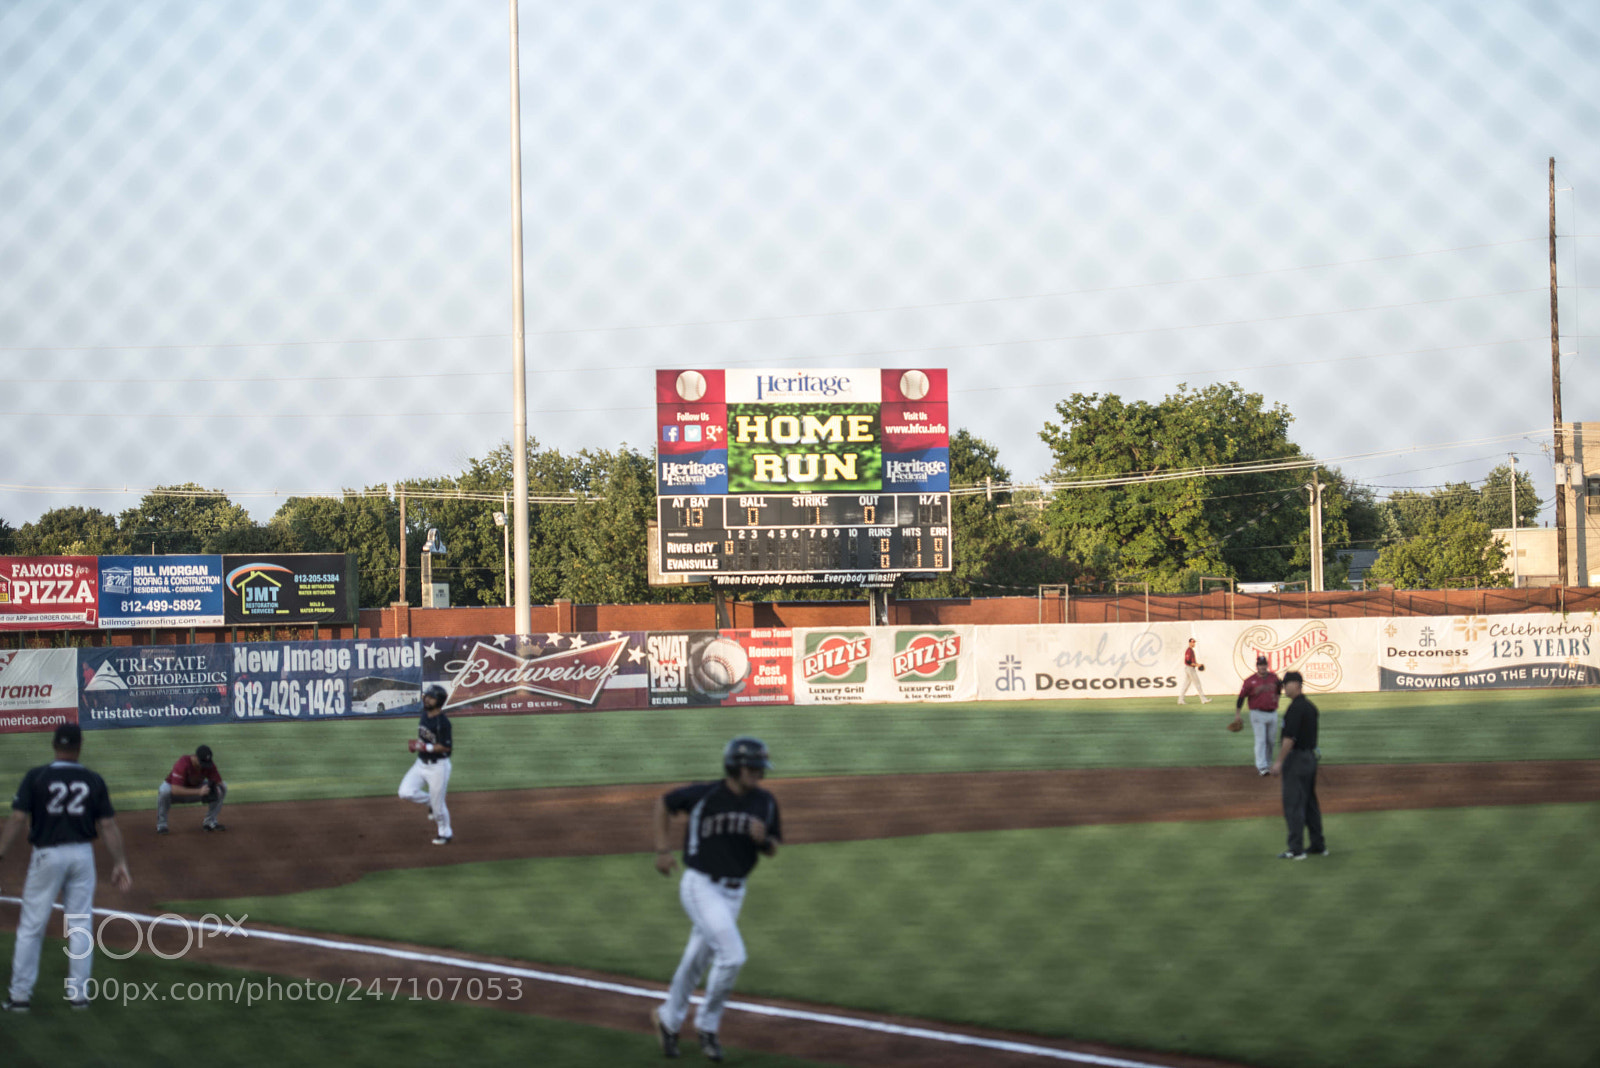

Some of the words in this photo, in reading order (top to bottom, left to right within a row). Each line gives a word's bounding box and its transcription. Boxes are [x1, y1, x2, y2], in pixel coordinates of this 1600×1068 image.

[757, 373, 850, 400] Heritage
[677, 412, 700, 421] Follow
[700, 412, 709, 421] Us
[903, 412, 918, 420] Visit
[919, 412, 928, 420] Us
[736, 415, 874, 444] HOME
[885, 424, 946, 434] www.hfcu.info
[662, 461, 726, 480] Heritage
[753, 453, 858, 482] RUN
[886, 459, 947, 478] Heritage
[667, 473, 706, 486] Federal
[891, 471, 927, 483] Federal
[672, 498, 685, 508] AT
[690, 498, 710, 508] BAT
[740, 497, 767, 507] BALL
[792, 496, 828, 507] STRIKE
[859, 496, 879, 505] OUT
[920, 495, 941, 505] H/E
[686, 508, 703, 527] 13
[748, 507, 759, 526] 0
[816, 506, 820, 524] 1
[864, 505, 875, 524] 0
[727, 530, 732, 539] 1
[738, 530, 746, 539] 2
[751, 530, 758, 539] 3
[767, 530, 775, 539] 4
[780, 530, 787, 539] 5
[792, 530, 799, 539] 6
[809, 529, 816, 538] 7
[821, 529, 828, 538] 8
[833, 529, 840, 538] 9
[849, 529, 858, 537] 10
[868, 528, 892, 537] RUNS
[902, 527, 922, 536] HITS
[930, 527, 948, 536] ERR
[667, 542, 693, 553] RIVER
[694, 542, 714, 553] CITY
[725, 540, 734, 554] 0
[880, 538, 890, 552] 0
[917, 538, 921, 551] 1
[934, 538, 943, 551] 0
[667, 559, 718, 569] EVANSVILLE
[881, 554, 890, 568] 0
[917, 554, 921, 567] 1
[12, 564, 73, 577] FAMOUS
[75, 565, 90, 578] for
[133, 566, 156, 576] BILL
[159, 565, 208, 576] MORGAN
[133, 577, 162, 585] ROOFING
[164, 576, 169, 585] &
[170, 576, 220, 584] CONSTRUCTION
[294, 574, 339, 583] 812-205-5384
[713, 576, 740, 584] "When
[742, 575, 785, 585] Everybody
[12, 580, 95, 604] PIZZA
[246, 586, 280, 601] JMT
[121, 600, 201, 612] 812-499-5892
[101, 618, 196, 626] billmorganroofing.com
[750, 630, 772, 638] Home
[773, 629, 792, 637] Team
[1490, 621, 1592, 638] Celebrating
[648, 635, 689, 664] SWAT
[748, 646, 793, 658] Homerun
[1387, 646, 1469, 658] Deaconess
[1492, 639, 1524, 658] 125
[1533, 637, 1591, 658] YEARS
[234, 647, 279, 673] New
[283, 645, 351, 673] Image
[355, 641, 421, 670] Travel
[805, 636, 868, 676] RITZY'S
[895, 635, 957, 676] RITZY'S
[116, 656, 206, 673] TRI-STATE
[759, 665, 780, 676] Pest
[126, 672, 227, 686] ORTHOPAEDICS
[444, 659, 619, 688] Budweiser
[650, 662, 688, 688] PEST
[753, 675, 787, 686] Control
[1396, 675, 1460, 689] GROWING
[1465, 673, 1497, 686] INTO
[1501, 669, 1527, 681] THE
[1532, 668, 1585, 681] FUTURE
[899, 685, 932, 693] Luxury
[934, 684, 954, 692] Grill
[1035, 673, 1177, 691] Deaconess
[234, 679, 345, 717] 812-426-1423
[809, 687, 841, 695] Luxury
[91, 704, 221, 719] tristate-ortho.com
[47, 782, 90, 815] 22
